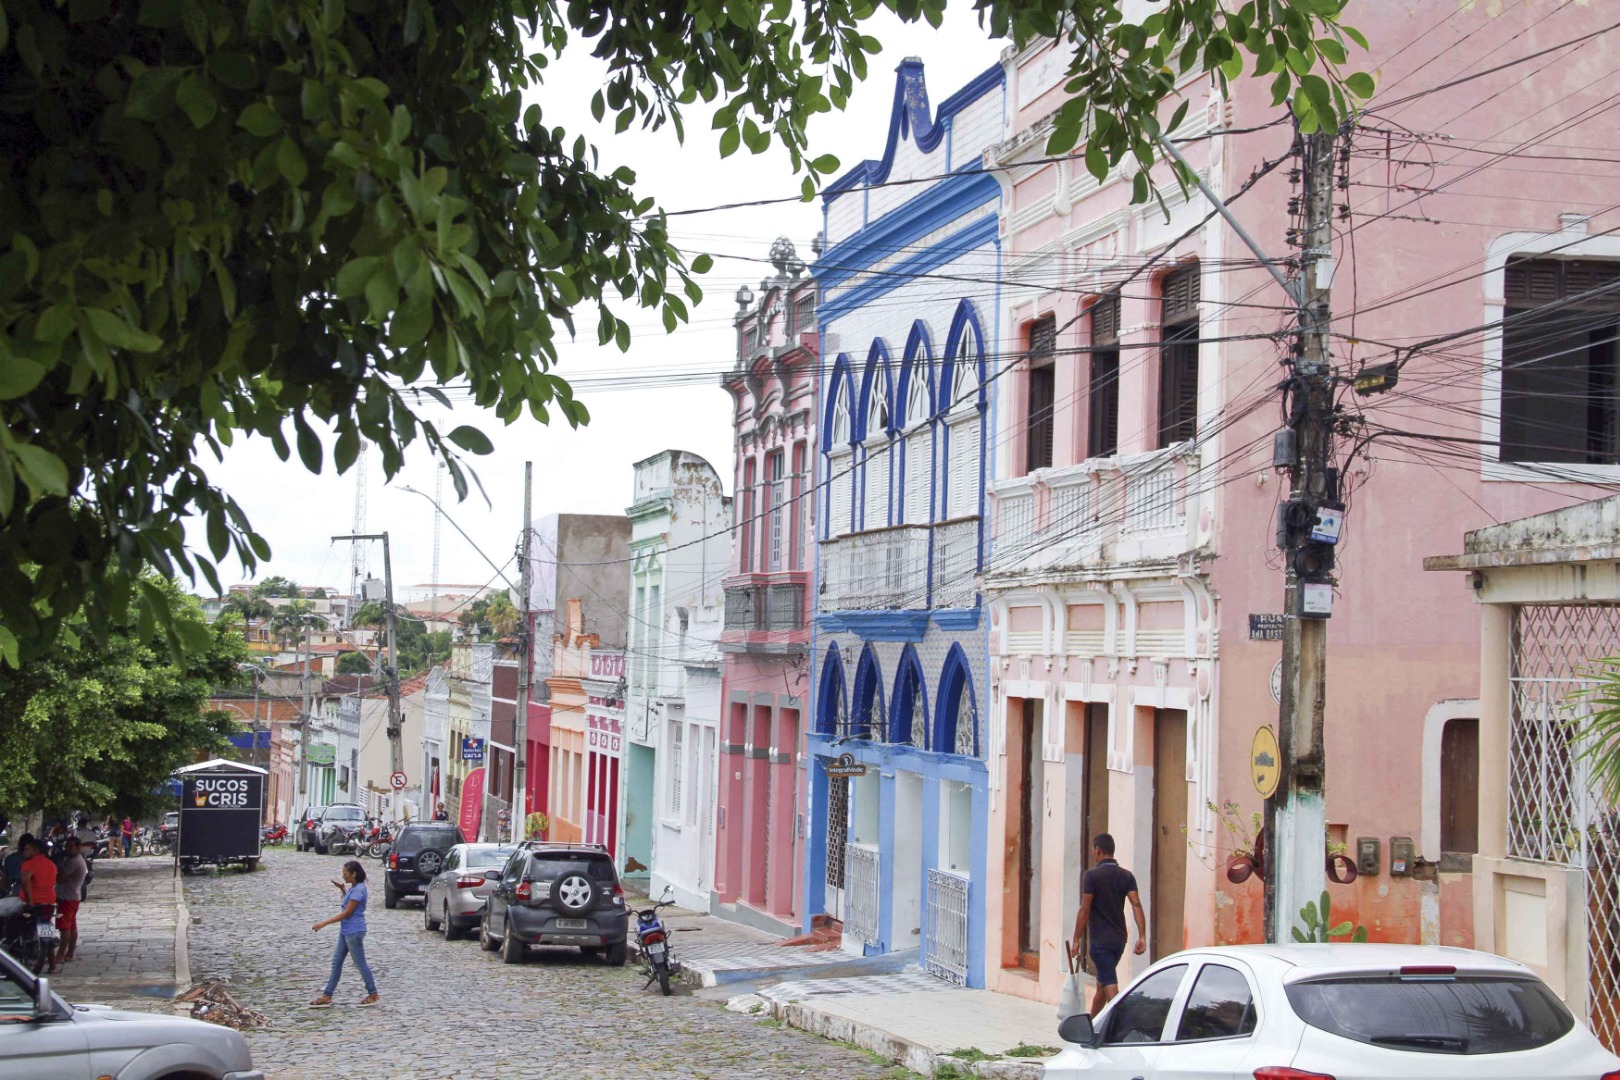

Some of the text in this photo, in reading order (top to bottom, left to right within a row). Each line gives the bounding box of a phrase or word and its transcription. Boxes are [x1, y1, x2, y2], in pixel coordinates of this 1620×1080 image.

[1260, 614, 1283, 623] RUA
[1265, 629, 1283, 639] BAST
[195, 779, 248, 791] SUCOS
[208, 792, 248, 805] CRIS
